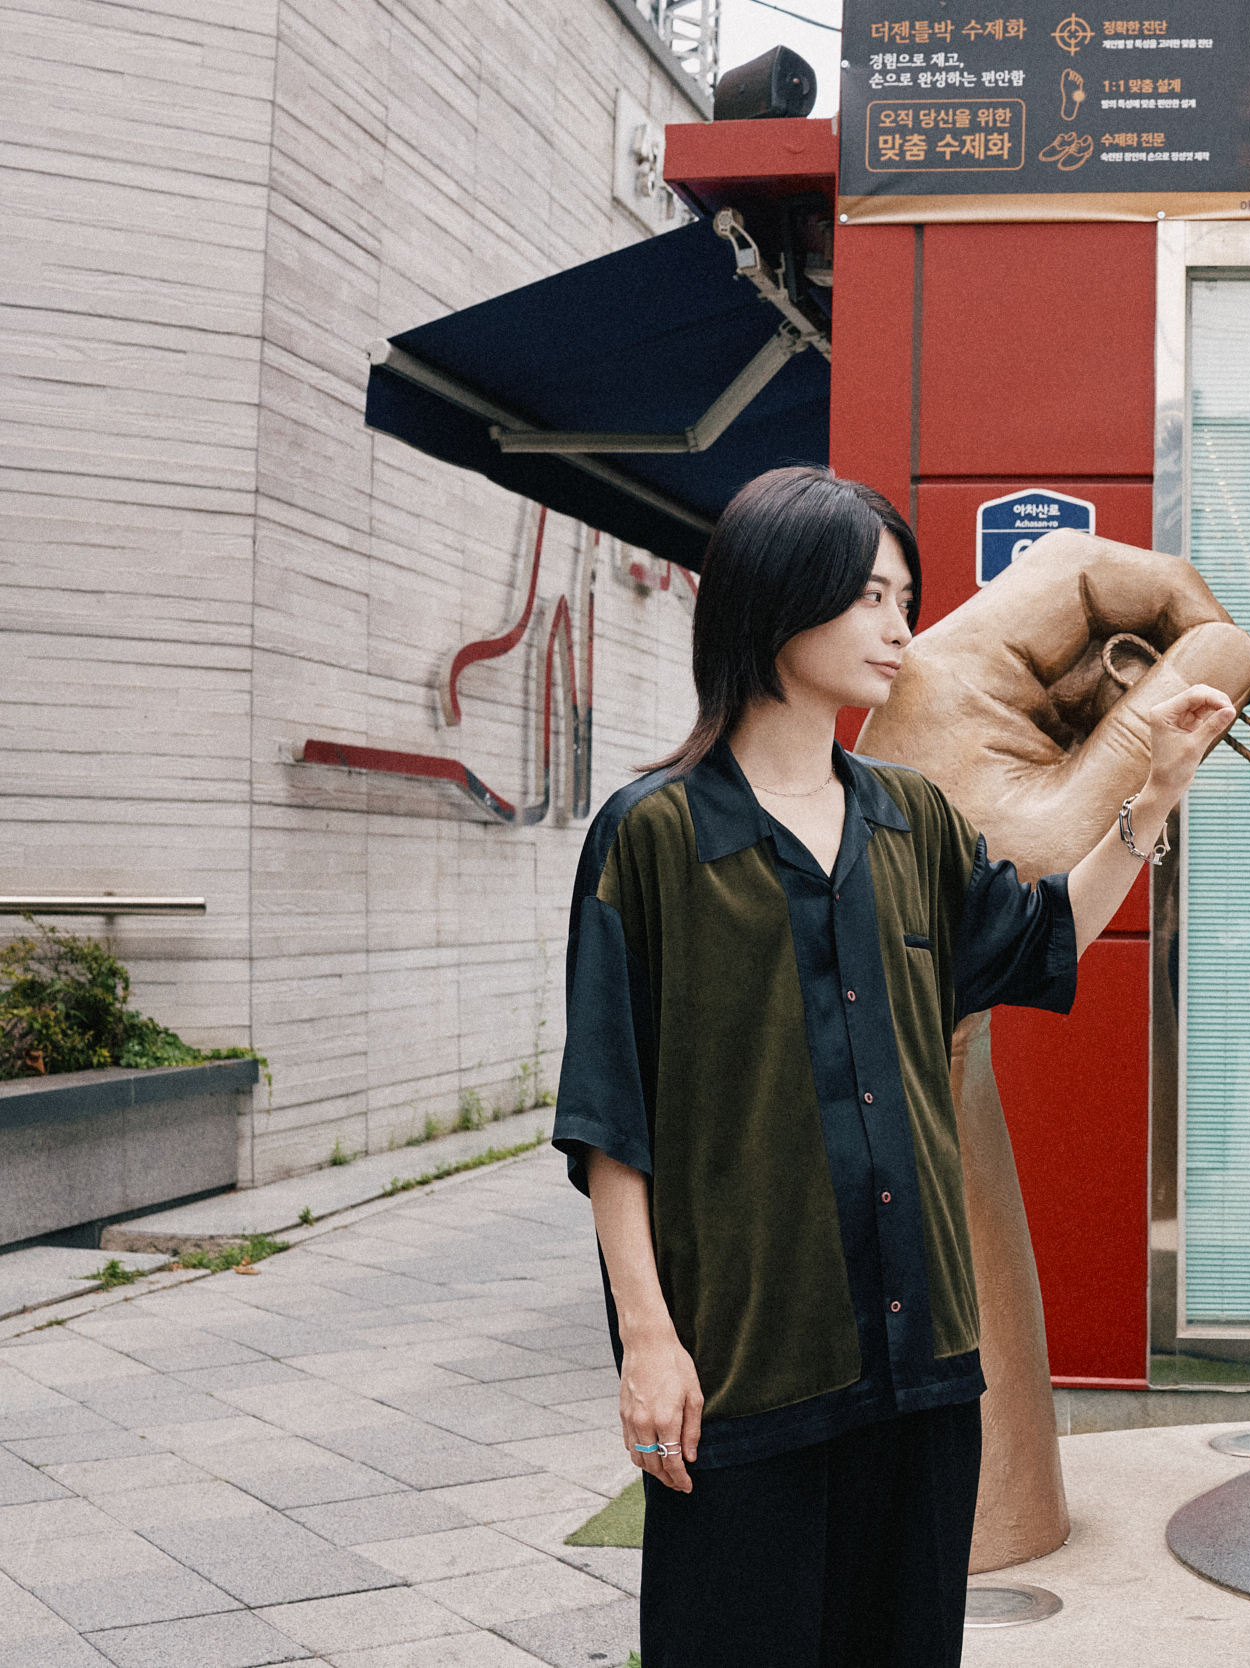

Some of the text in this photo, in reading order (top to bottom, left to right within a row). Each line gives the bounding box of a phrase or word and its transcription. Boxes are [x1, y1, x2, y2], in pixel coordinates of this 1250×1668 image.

[870, 18, 1027, 44] 더젠틀박 수제화
[1103, 20, 1168, 35] 정확한 진단
[1197, 38, 1213, 48] 진단
[869, 52, 964, 70] 경험으로 재고,
[869, 70, 1025, 89] 손으로 완성하는 편안함
[1103, 78, 1181, 93] 1:1 맞춤 설계
[878, 107, 1012, 129] 오직 당신을 위한
[878, 132, 1012, 161] 맞춤 수제화
[1101, 132, 1166, 148] 수제화 전문
[1147, 152, 1171, 162] 손으로
[1013, 504, 1060, 518] 아차산로
[1014, 519, 1058, 528] Achasan-ro
